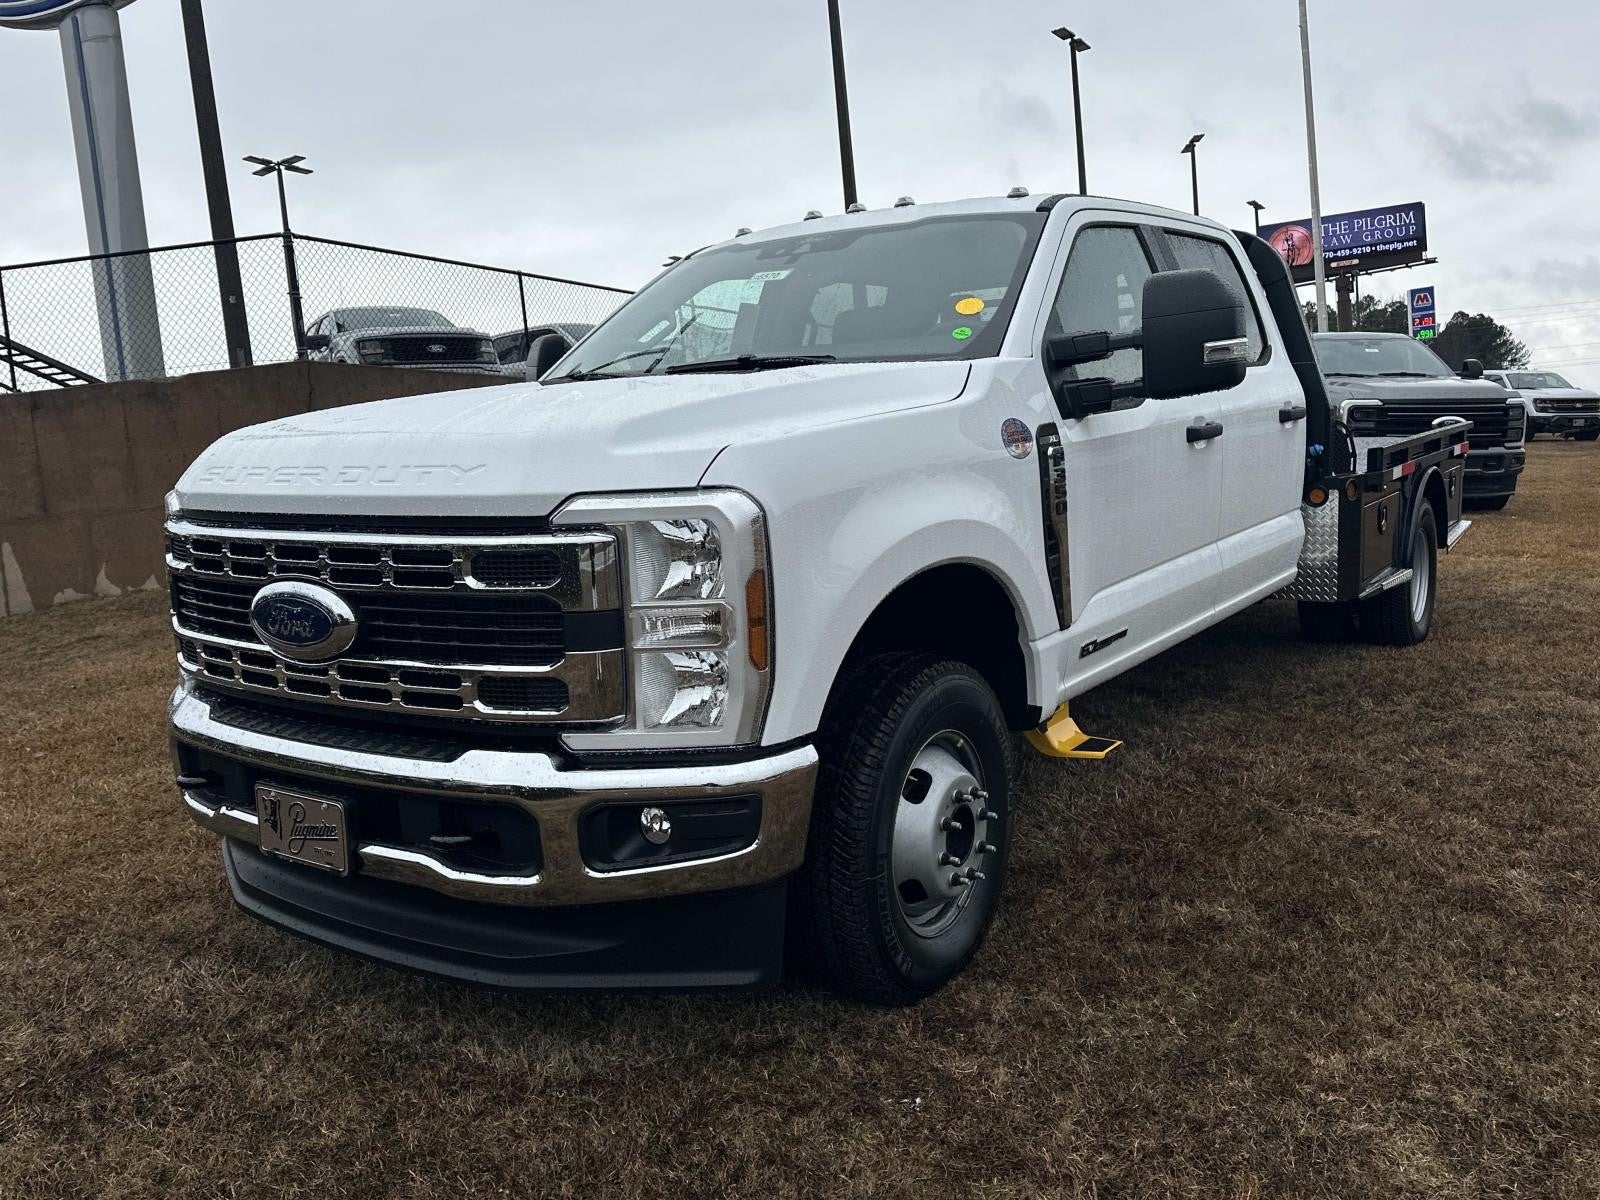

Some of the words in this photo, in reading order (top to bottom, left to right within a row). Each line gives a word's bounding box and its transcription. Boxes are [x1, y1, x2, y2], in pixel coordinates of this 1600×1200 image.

[1321, 221, 1350, 236] THE
[1354, 211, 1415, 232] PILGRIM
[1362, 225, 1416, 241] GROUP
[198, 465, 329, 486] SUPER
[333, 464, 487, 487] DUTY
[267, 603, 315, 638] Ford
